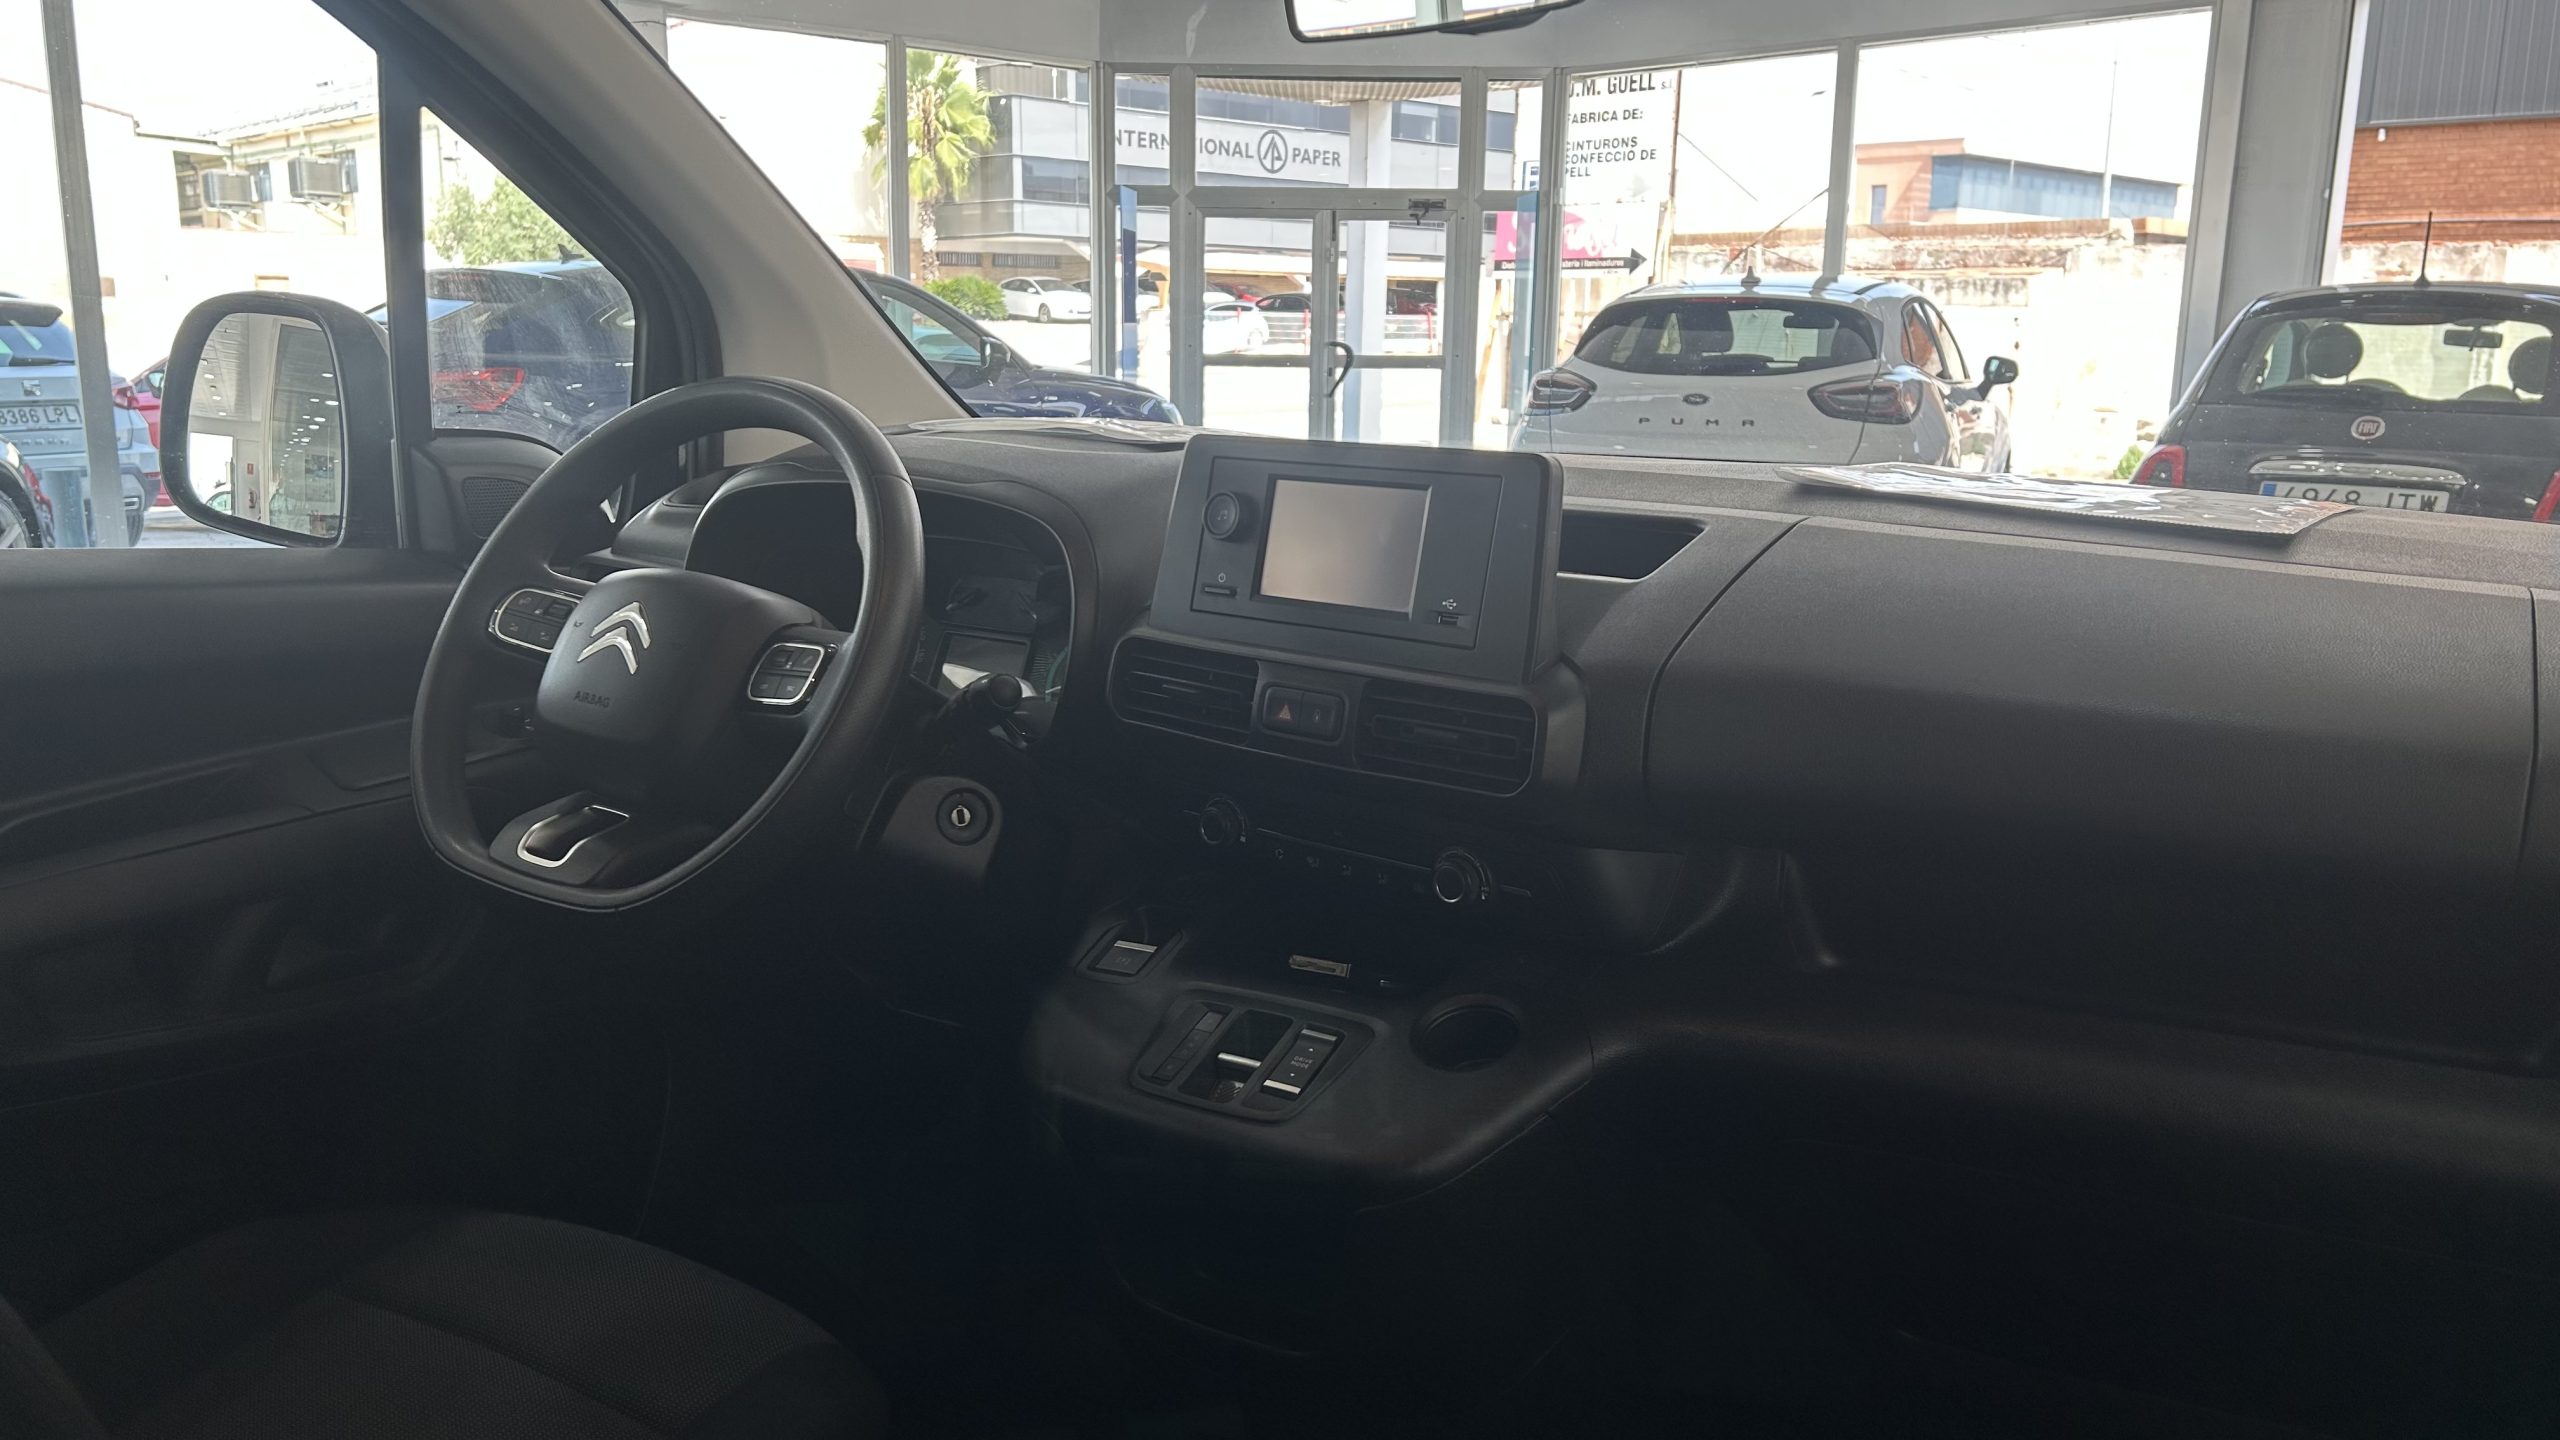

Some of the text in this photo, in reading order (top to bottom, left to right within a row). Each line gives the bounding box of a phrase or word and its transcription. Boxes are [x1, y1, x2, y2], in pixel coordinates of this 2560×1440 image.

[1623, 108, 1643, 121] DE:
[1115, 129, 1341, 168] NTERNIONAL PAPER
[1640, 149, 1657, 161] DE
[1638, 417, 1755, 427] PUMA
